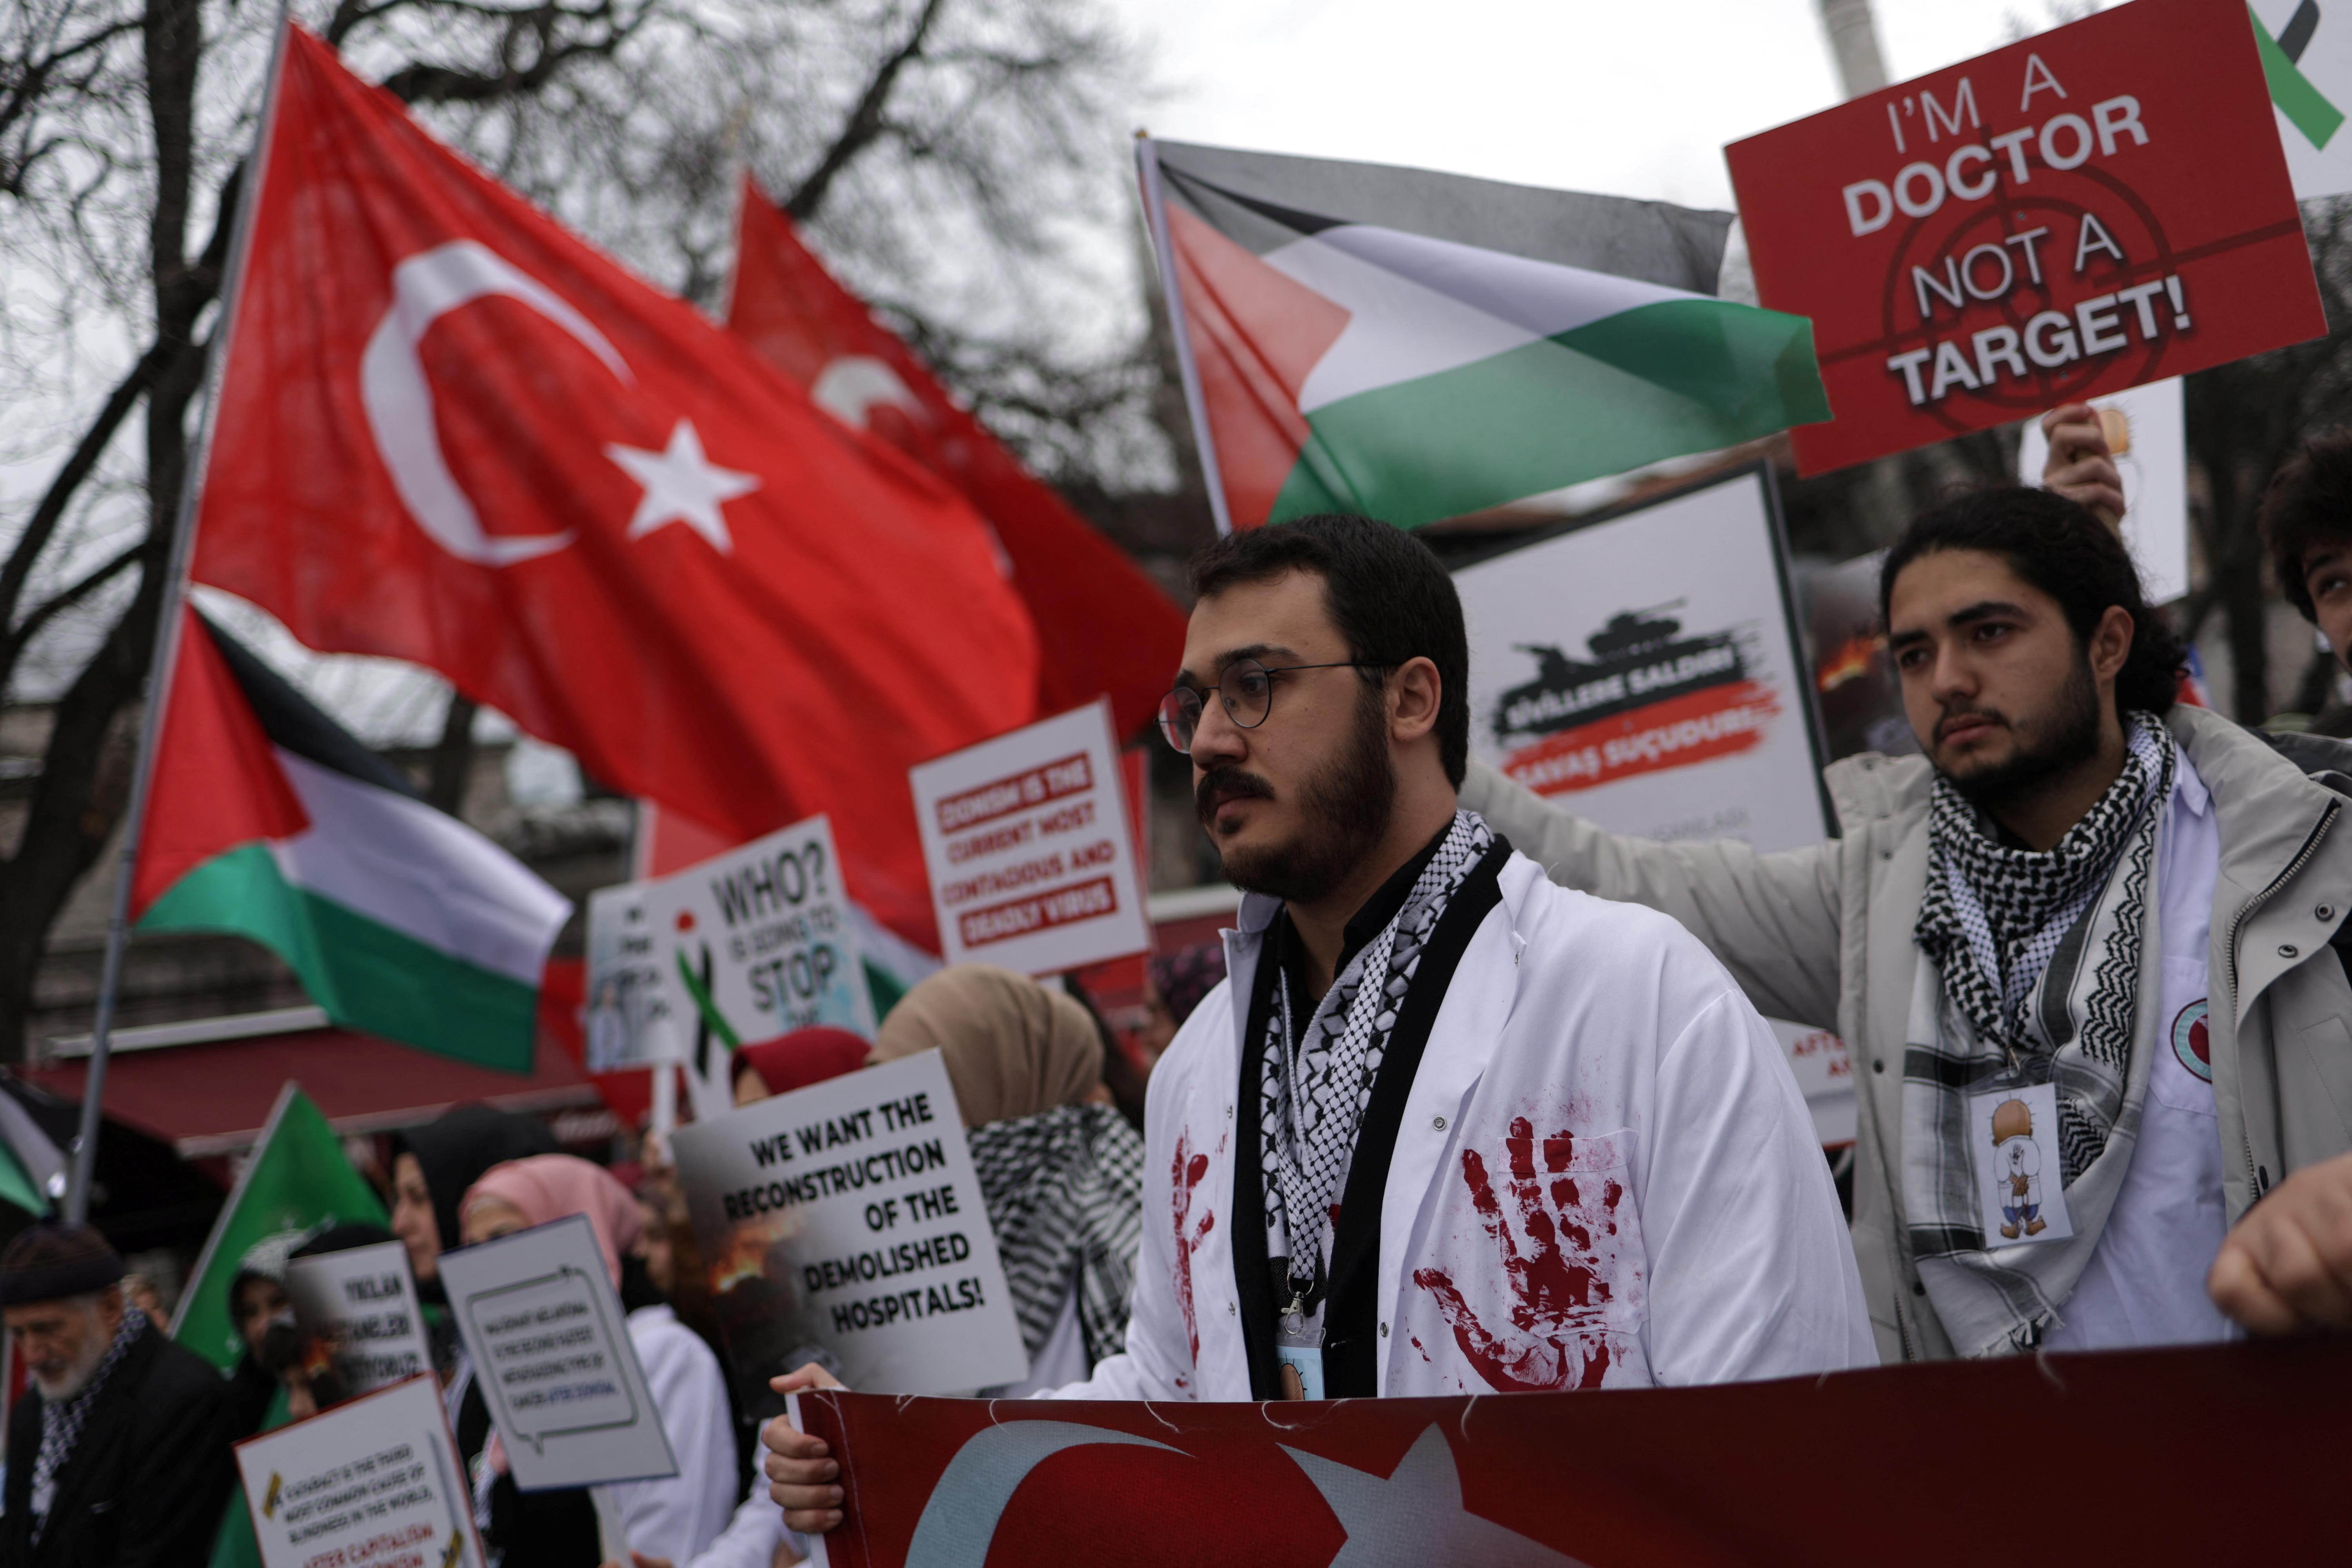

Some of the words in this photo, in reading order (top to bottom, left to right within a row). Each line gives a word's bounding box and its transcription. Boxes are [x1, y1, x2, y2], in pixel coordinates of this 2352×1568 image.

[1886, 76, 1981, 154] I'M
[2020, 52, 2067, 112] A
[1842, 95, 2149, 238] DOCTOR
[1911, 227, 2047, 318] NOT
[2074, 212, 2122, 272] A
[1887, 274, 2192, 406] TARGET!
[1630, 645, 1734, 692] SALDIRI
[1024, 778, 1044, 801] IS
[1047, 762, 1087, 791] THE
[1514, 746, 1600, 785] SAVAŞ
[949, 822, 1031, 862] CURRENT
[1038, 804, 1093, 835] MOST
[710, 840, 828, 929] WHO?
[943, 856, 1063, 902] CONTAGIOUS
[1071, 841, 1114, 868] AND
[751, 916, 808, 955] GOING
[811, 903, 838, 934] TO
[966, 902, 1040, 939] DEADLY
[1044, 885, 1109, 921] VIRUS
[750, 944, 836, 1012] STOP
[750, 1132, 792, 1169] WE
[796, 1109, 875, 1155] WANT
[879, 1093, 933, 1133] THE
[723, 1138, 946, 1222] RECONSTRUCTION
[865, 1199, 898, 1232] OF
[904, 1185, 959, 1224] THE
[804, 1233, 970, 1293] DEMOLISHED
[831, 1278, 985, 1334] HOSPITALS!
[284, 1505, 313, 1523] MOST
[316, 1486, 368, 1513] COMMON
[371, 1471, 407, 1493] CAUSE
[409, 1464, 425, 1482] OF
[286, 1473, 341, 1499] CATARACT
[353, 1459, 376, 1475] THE
[377, 1446, 411, 1467] THIRD
[289, 1516, 348, 1544] BLINDNESS
[350, 1511, 364, 1523] IN
[365, 1503, 388, 1519] THE
[347, 1523, 434, 1562] CAPITALISM
